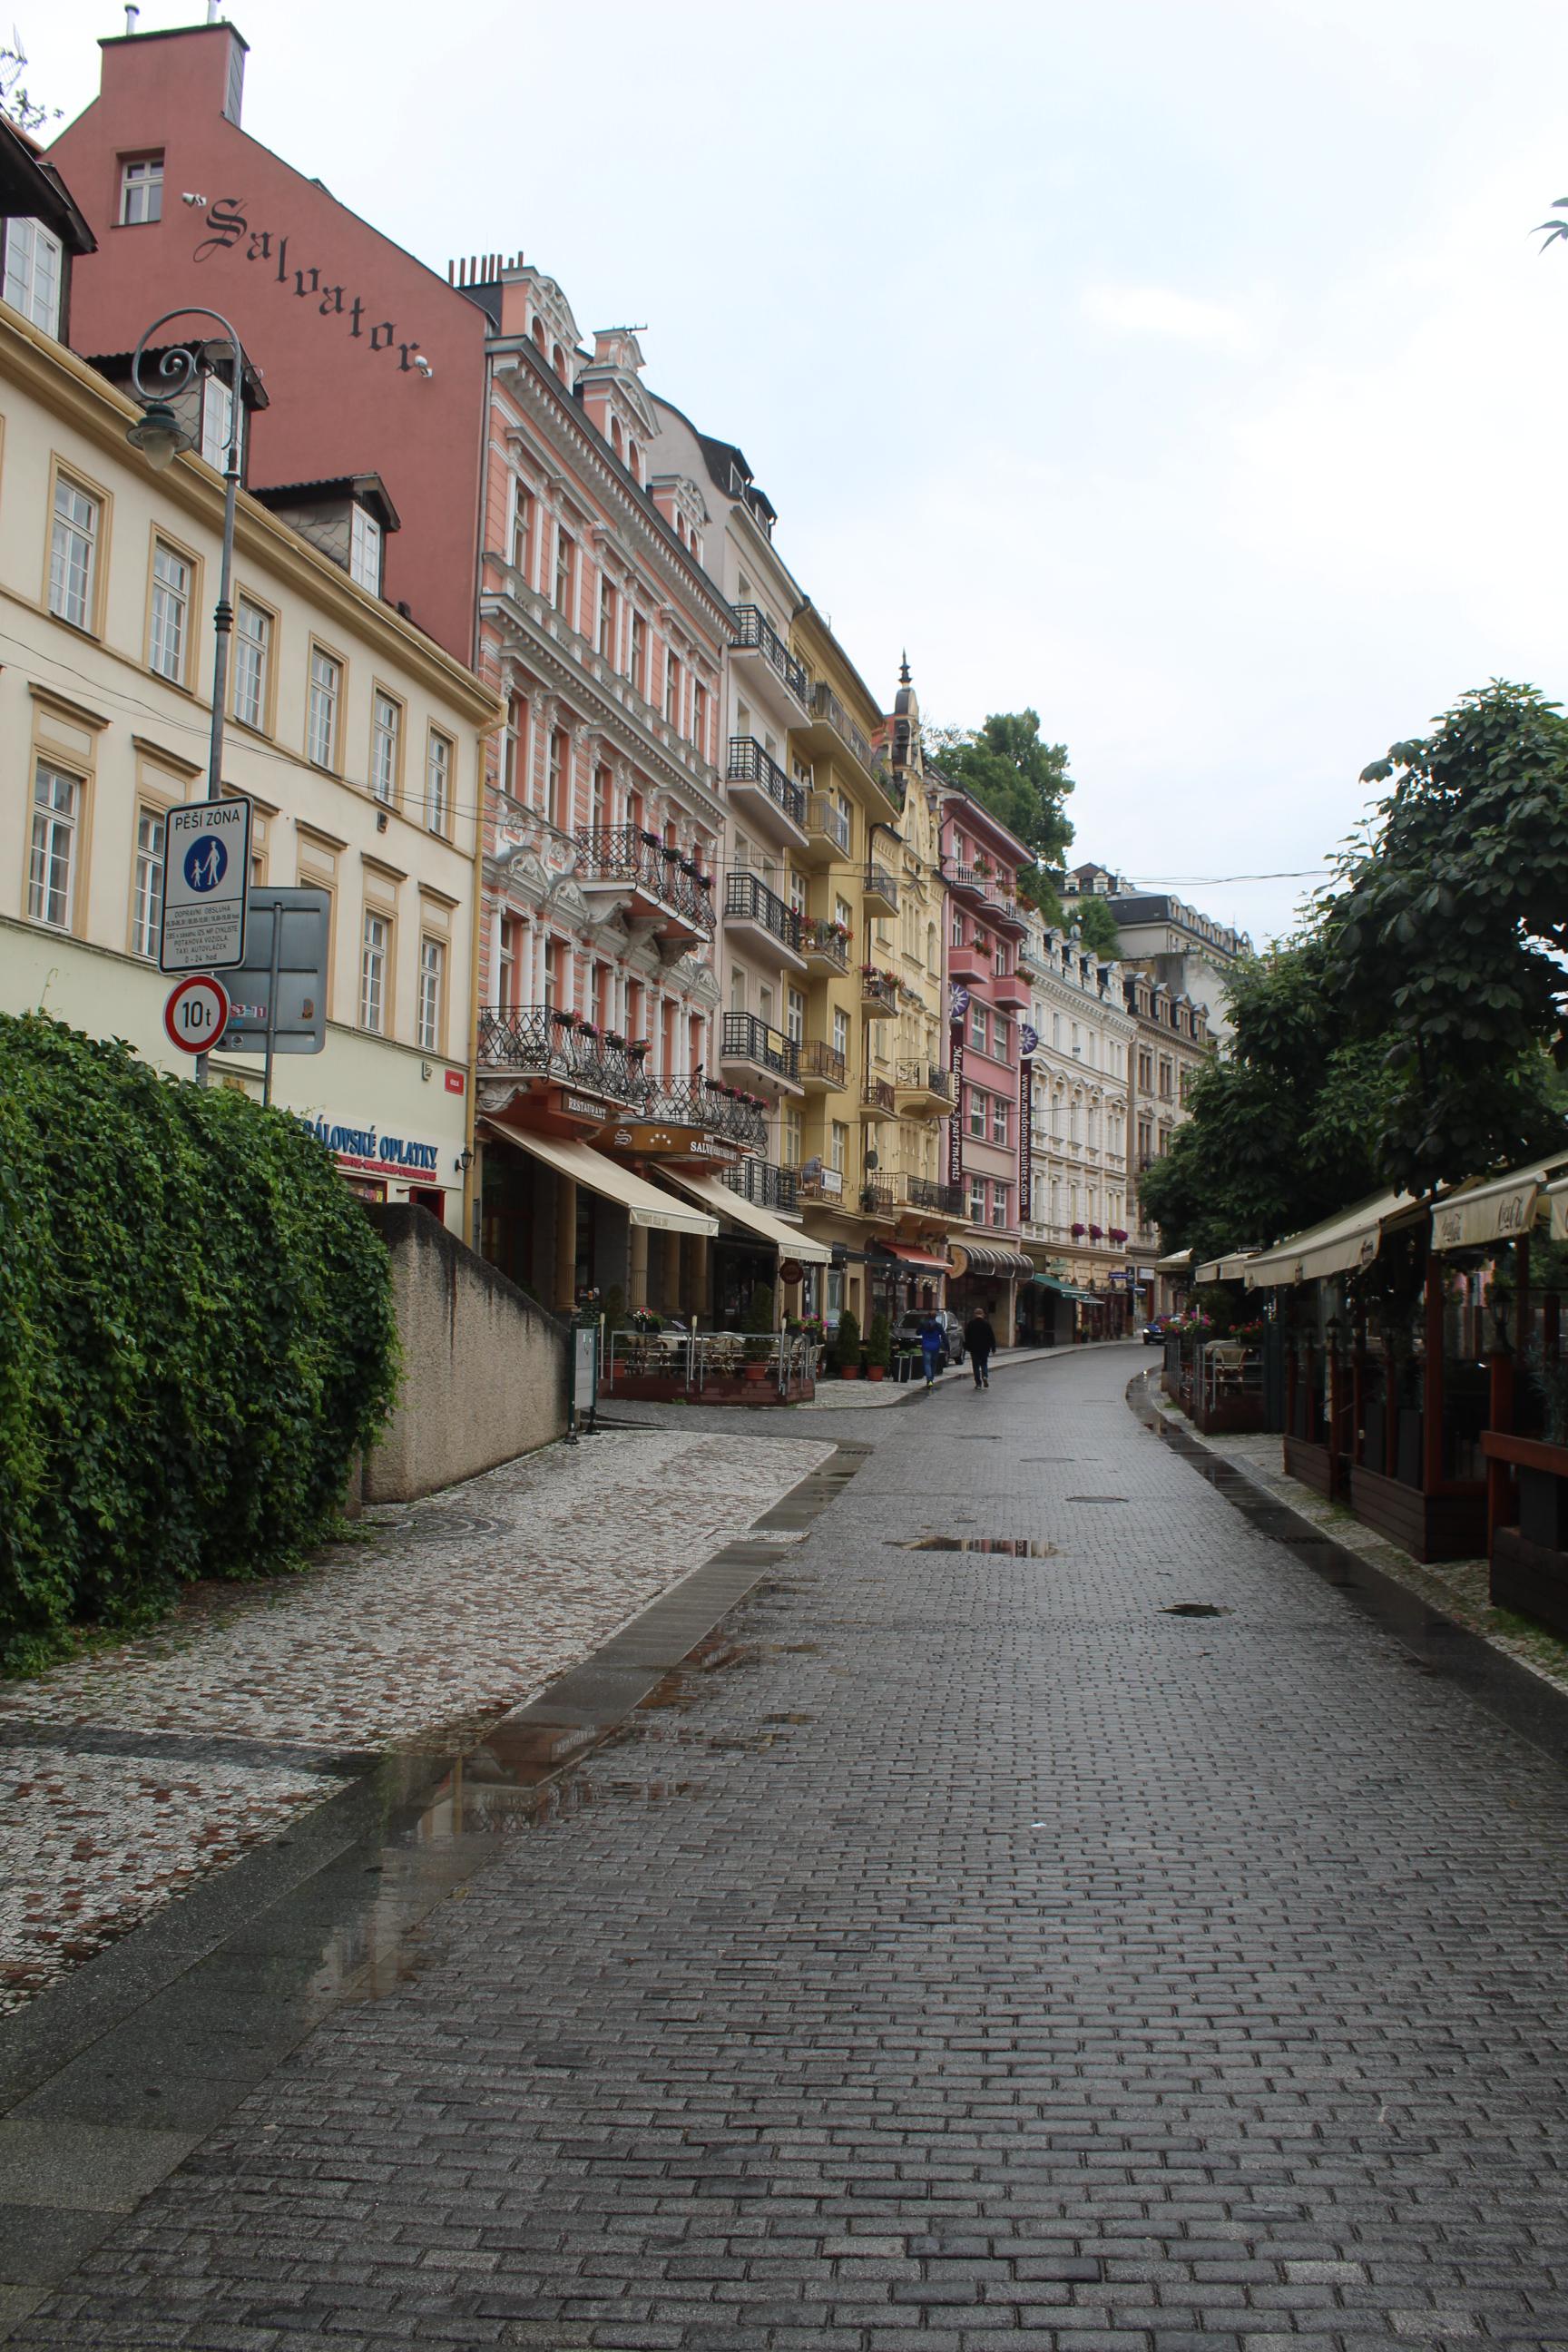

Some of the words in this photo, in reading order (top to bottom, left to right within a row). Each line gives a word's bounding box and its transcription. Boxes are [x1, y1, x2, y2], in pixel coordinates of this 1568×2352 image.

[193, 198, 420, 372] Salvator
[175, 810, 202, 830] PĚŠÍ
[206, 808, 240, 827] ZÓNA
[182, 1001, 203, 1028] 10
[205, 1008, 211, 1026] t
[568, 1097, 606, 1120] RESTAURANT
[293, 1114, 377, 1157] RÁLOVSKÉ
[379, 1135, 438, 1170] OPLATKY
[1020, 1073, 1031, 1206] www.madonnasuites.com
